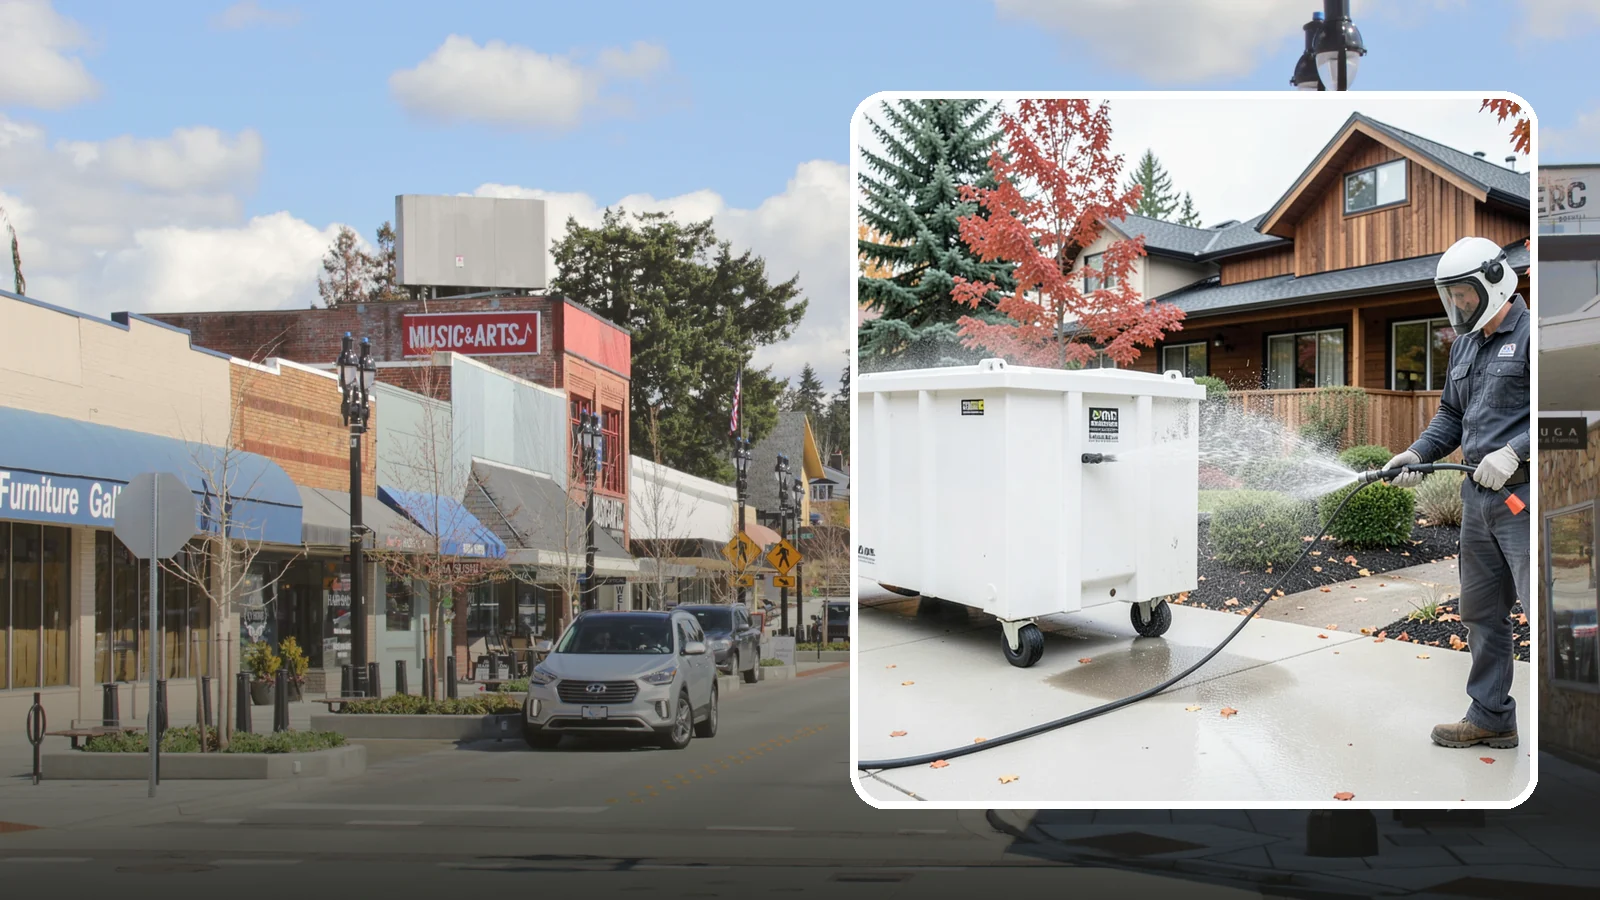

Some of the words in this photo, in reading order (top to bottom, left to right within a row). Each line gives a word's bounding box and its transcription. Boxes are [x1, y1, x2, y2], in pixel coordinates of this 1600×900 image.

[409, 323, 520, 348] MUSIC&ARTS
[0, 471, 80, 515] Furniture
[89, 482, 121, 519] Gal
[453, 563, 479, 574] SUSHI
